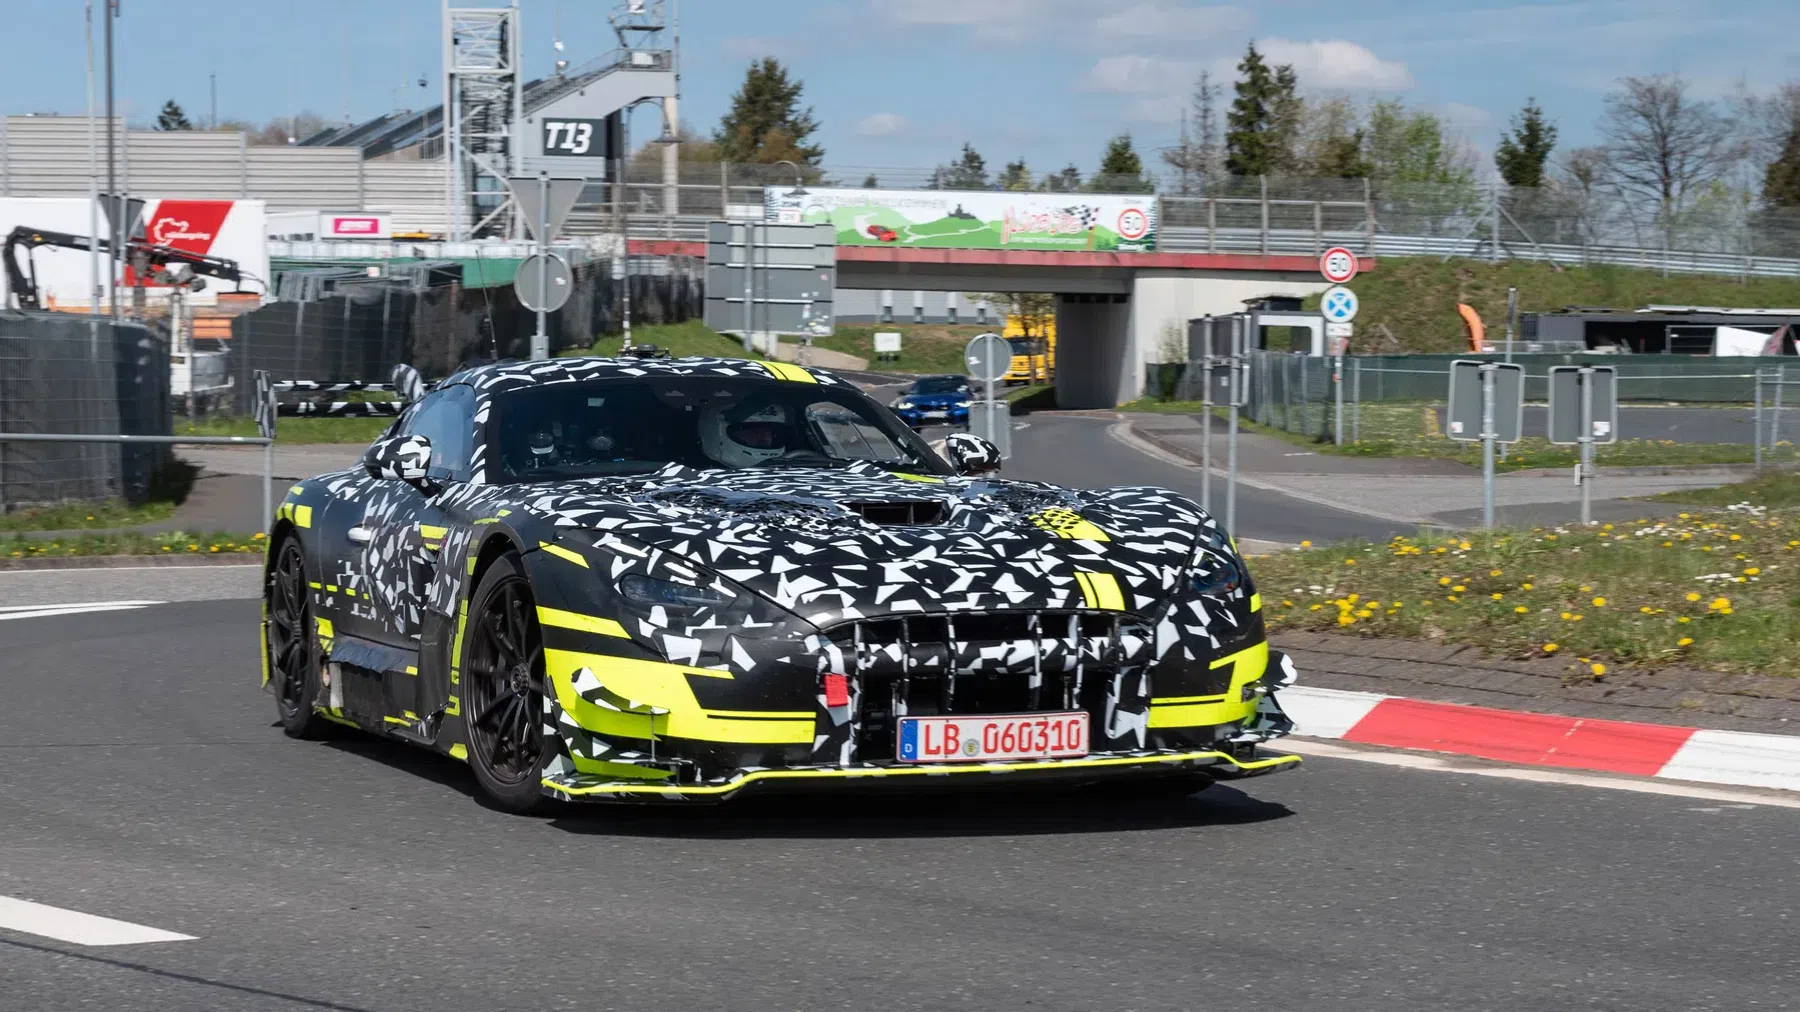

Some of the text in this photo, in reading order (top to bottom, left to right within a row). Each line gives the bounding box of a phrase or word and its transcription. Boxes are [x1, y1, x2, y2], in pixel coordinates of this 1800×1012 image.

[545, 122, 593, 154] T13
[1330, 257, 1348, 273] 50
[904, 719, 1081, 755] D LB 060310
